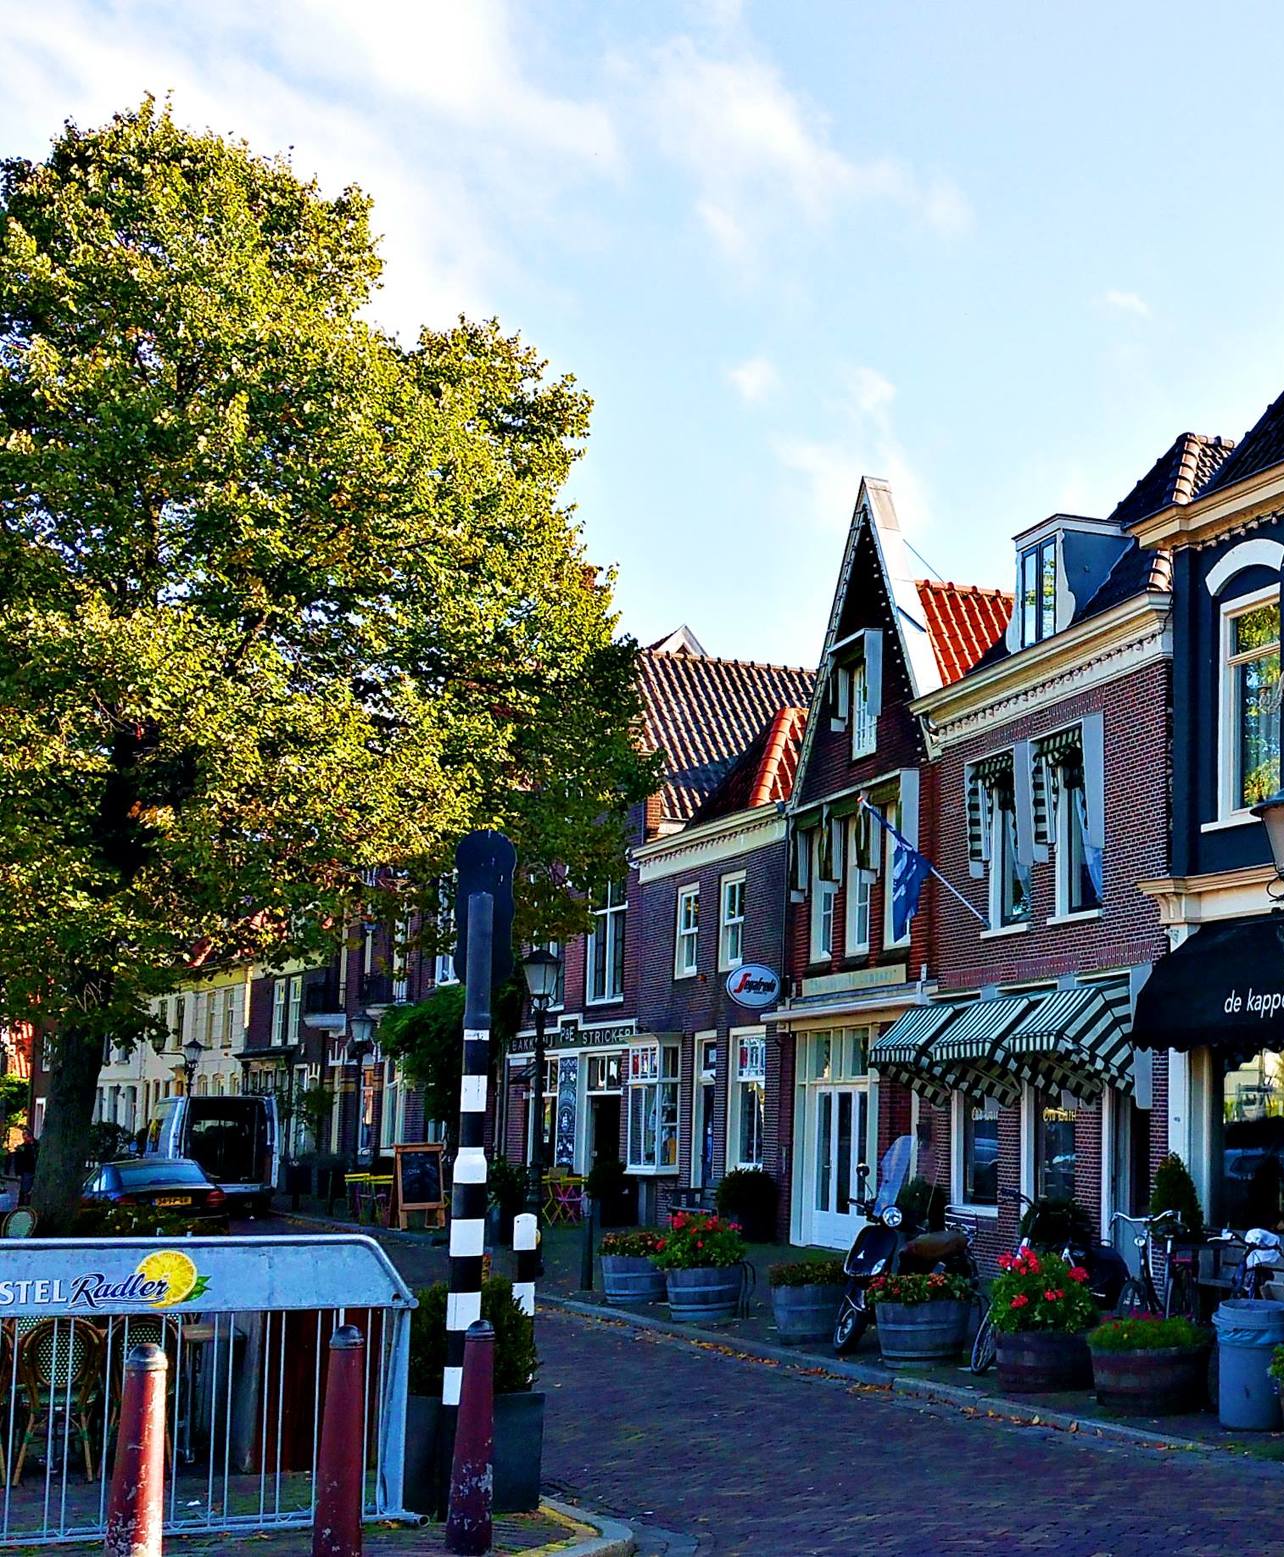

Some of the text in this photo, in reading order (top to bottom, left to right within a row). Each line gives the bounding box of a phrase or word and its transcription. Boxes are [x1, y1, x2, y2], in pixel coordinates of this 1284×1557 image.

[1224, 989, 1242, 1013] de
[511, 1036, 554, 1052] BAKKIJ
[0, 1272, 169, 1309] STEL Radler
